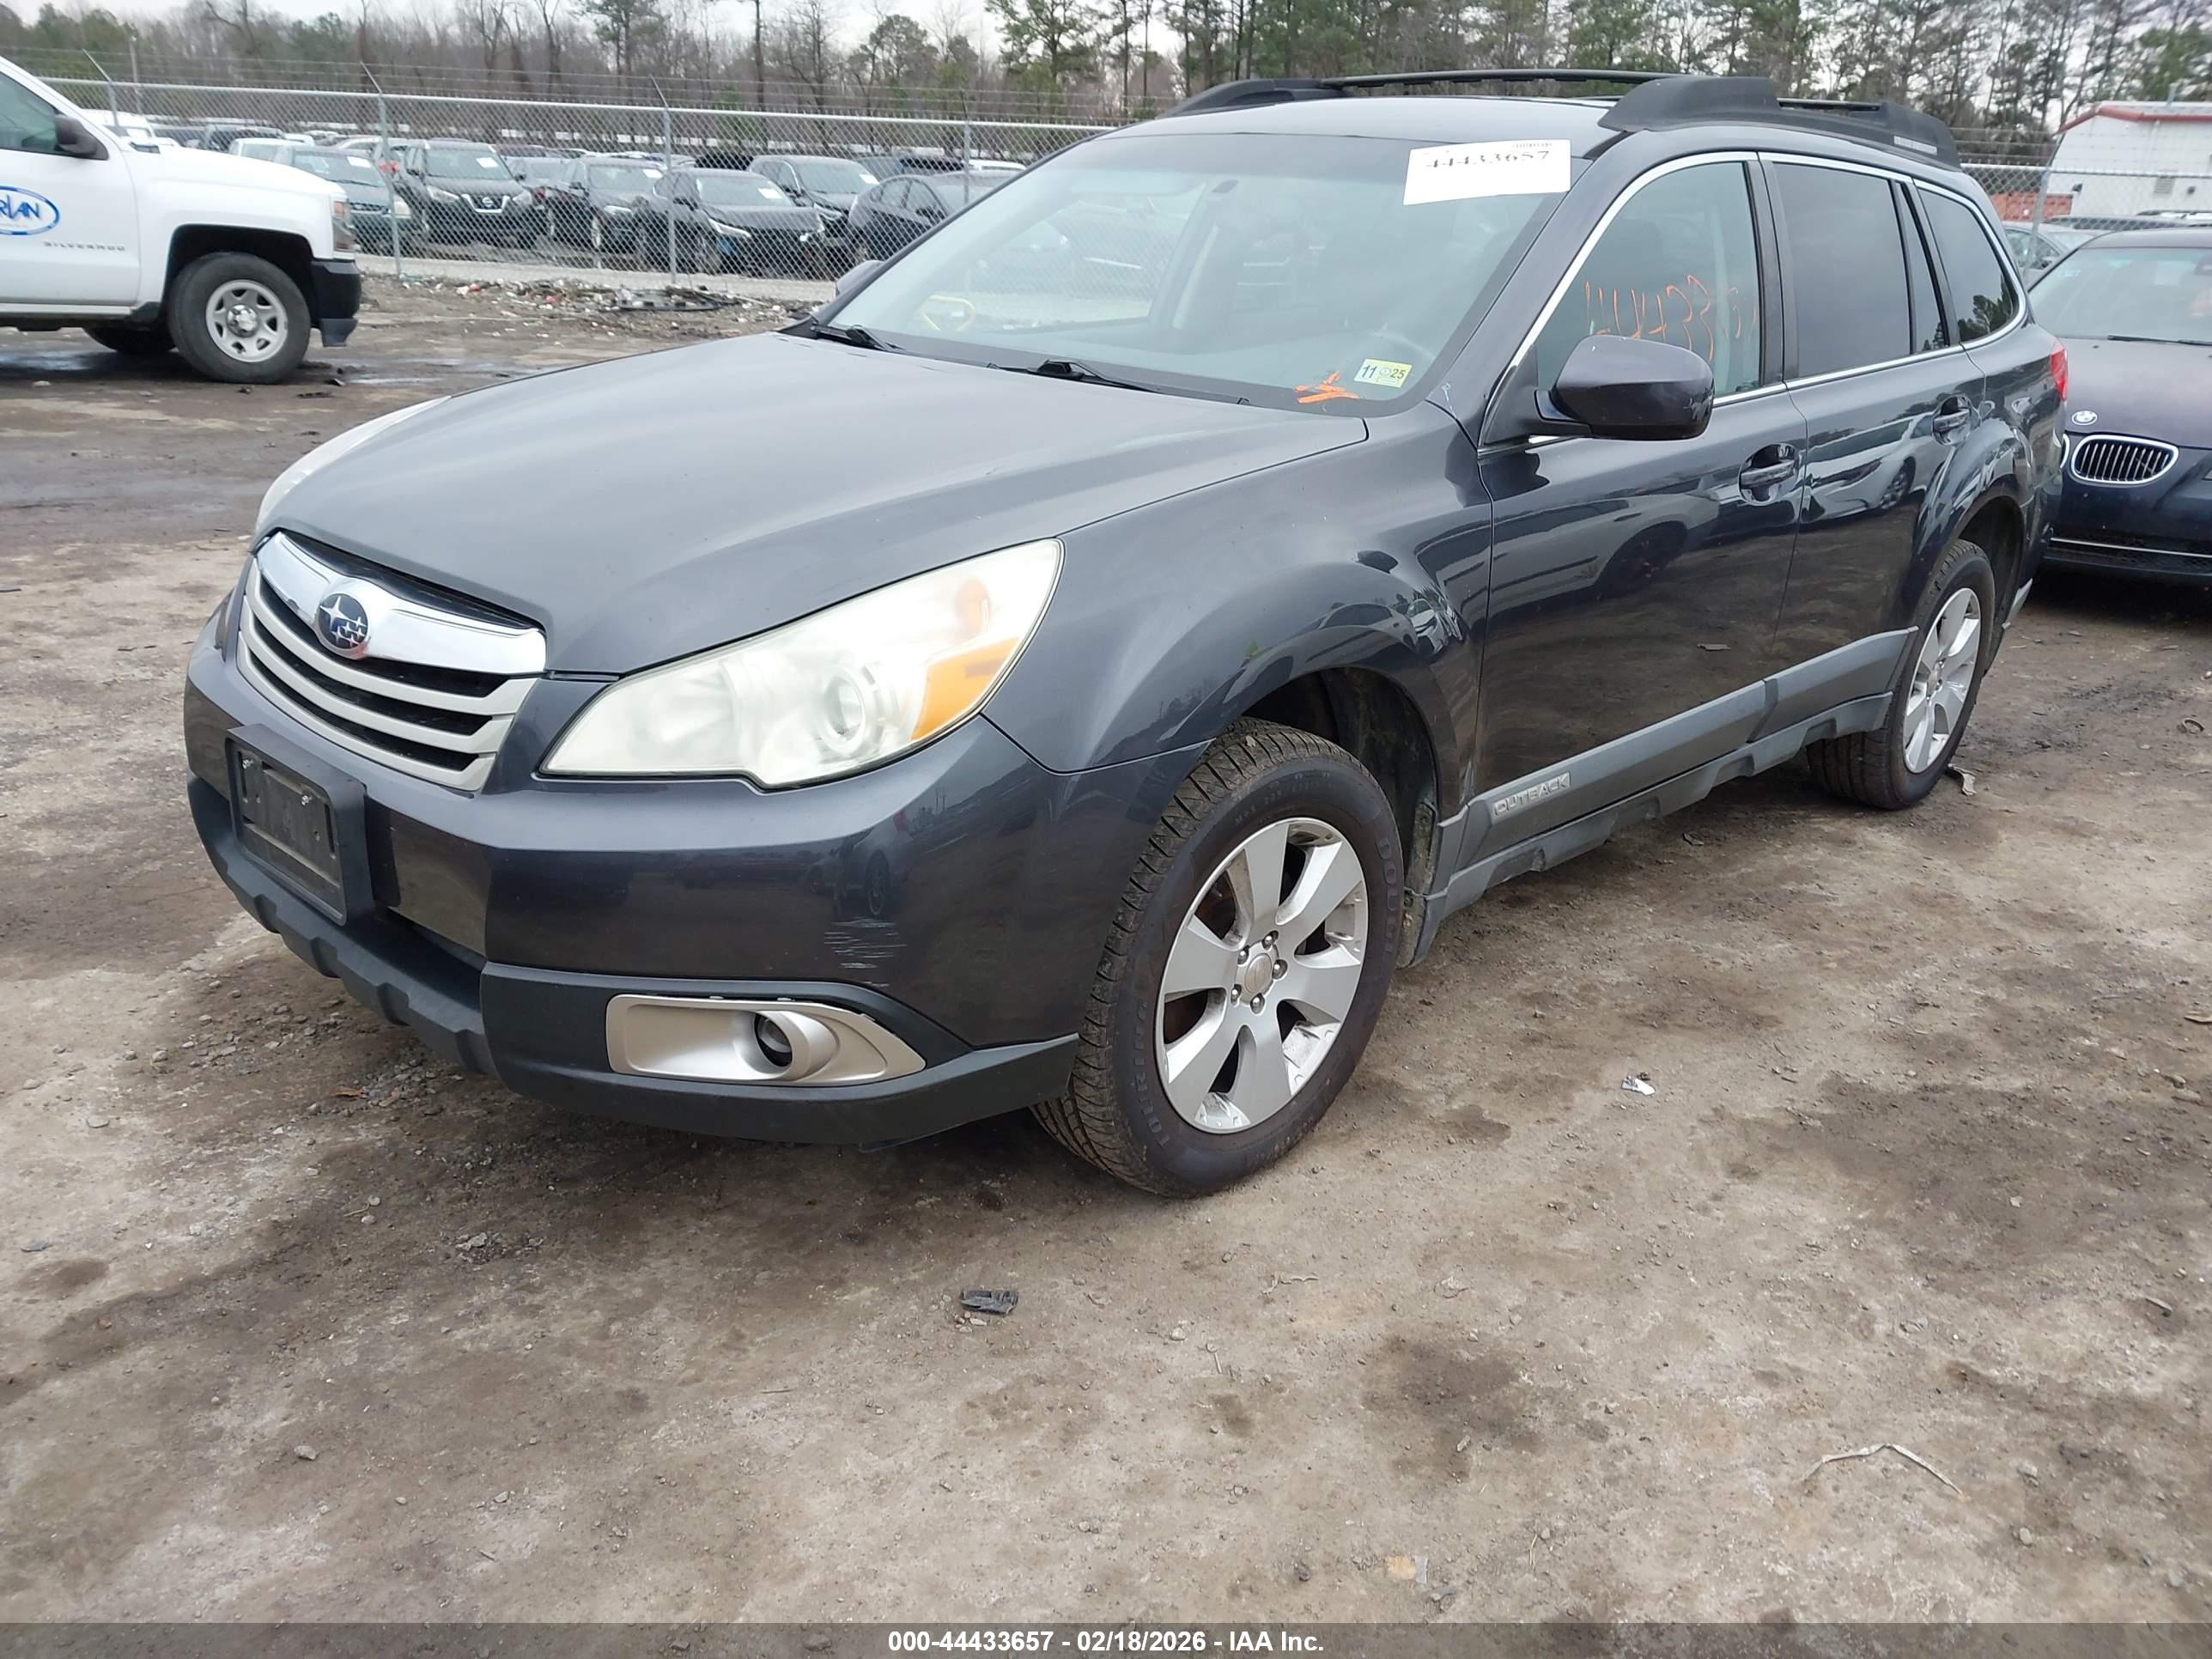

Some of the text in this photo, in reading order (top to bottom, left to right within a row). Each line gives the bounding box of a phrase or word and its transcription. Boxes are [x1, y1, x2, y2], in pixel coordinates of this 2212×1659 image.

[1361, 364, 1407, 380] 11 25
[1493, 773, 1569, 816] OUTBACK
